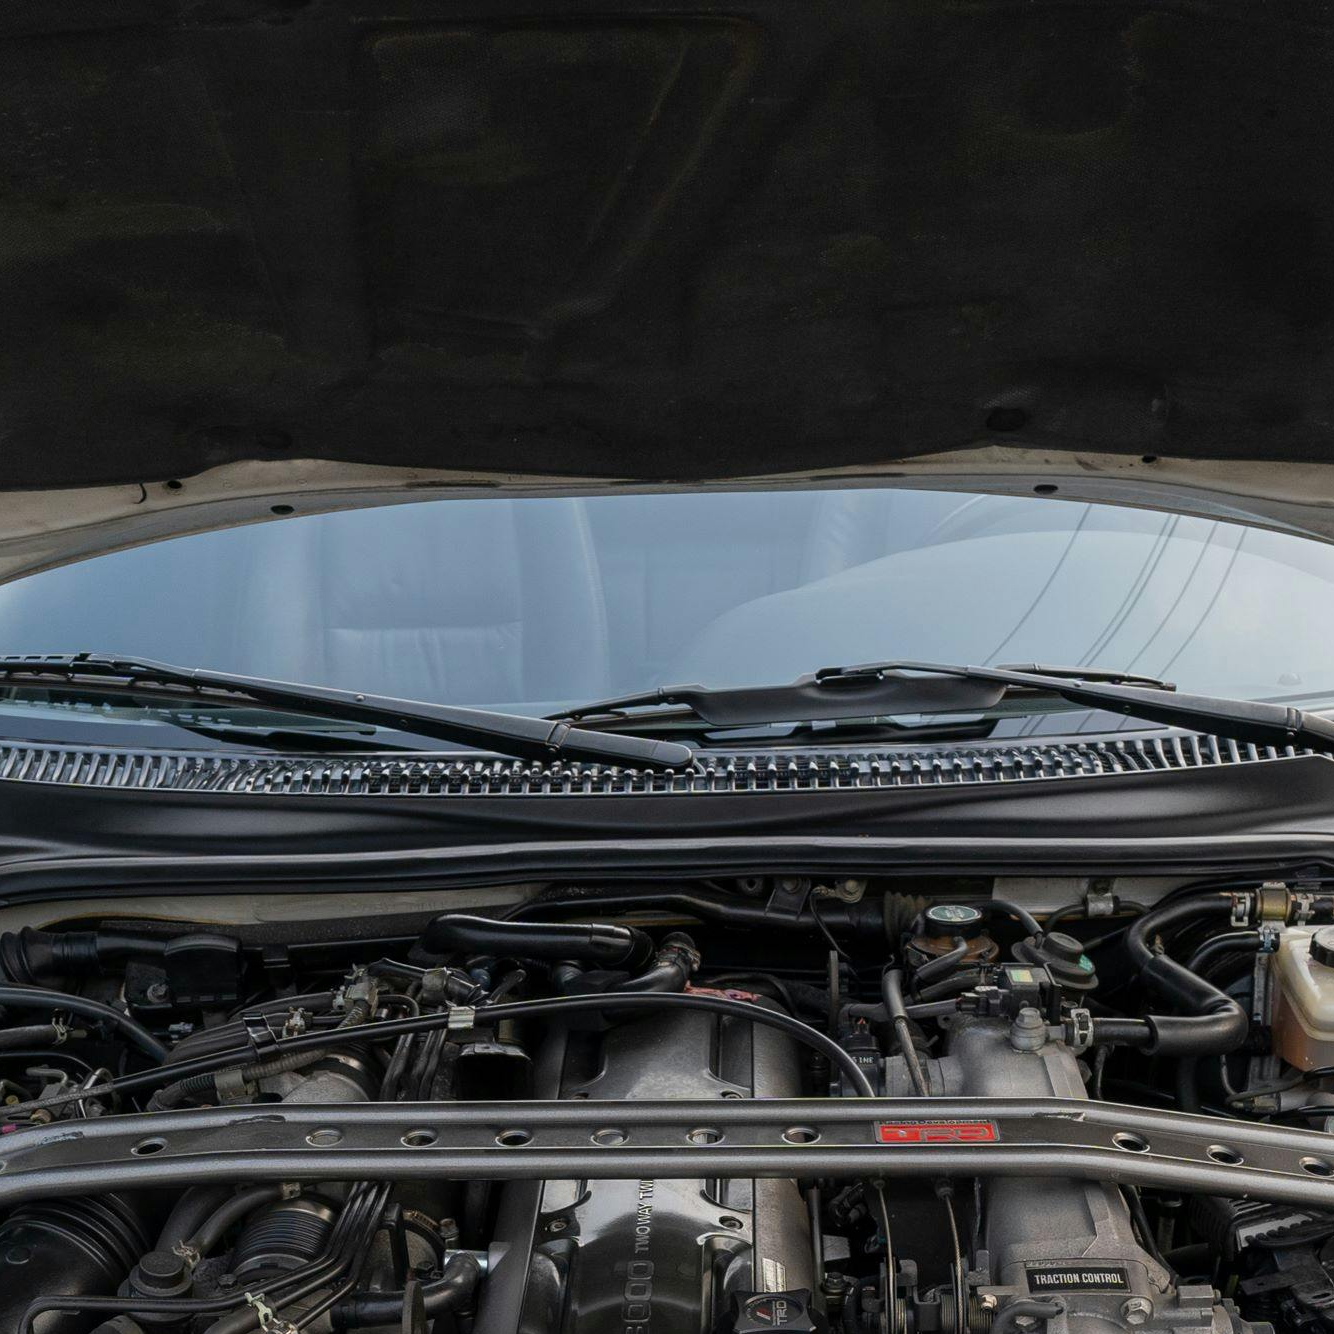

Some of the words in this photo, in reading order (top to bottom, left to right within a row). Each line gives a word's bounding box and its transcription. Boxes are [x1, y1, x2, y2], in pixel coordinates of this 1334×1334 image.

[884, 1127, 990, 1142] TRD
[1034, 1273, 1080, 1285] TRACTION
[1081, 1273, 1124, 1284] CONTROL
[776, 1300, 788, 1326] TRD
